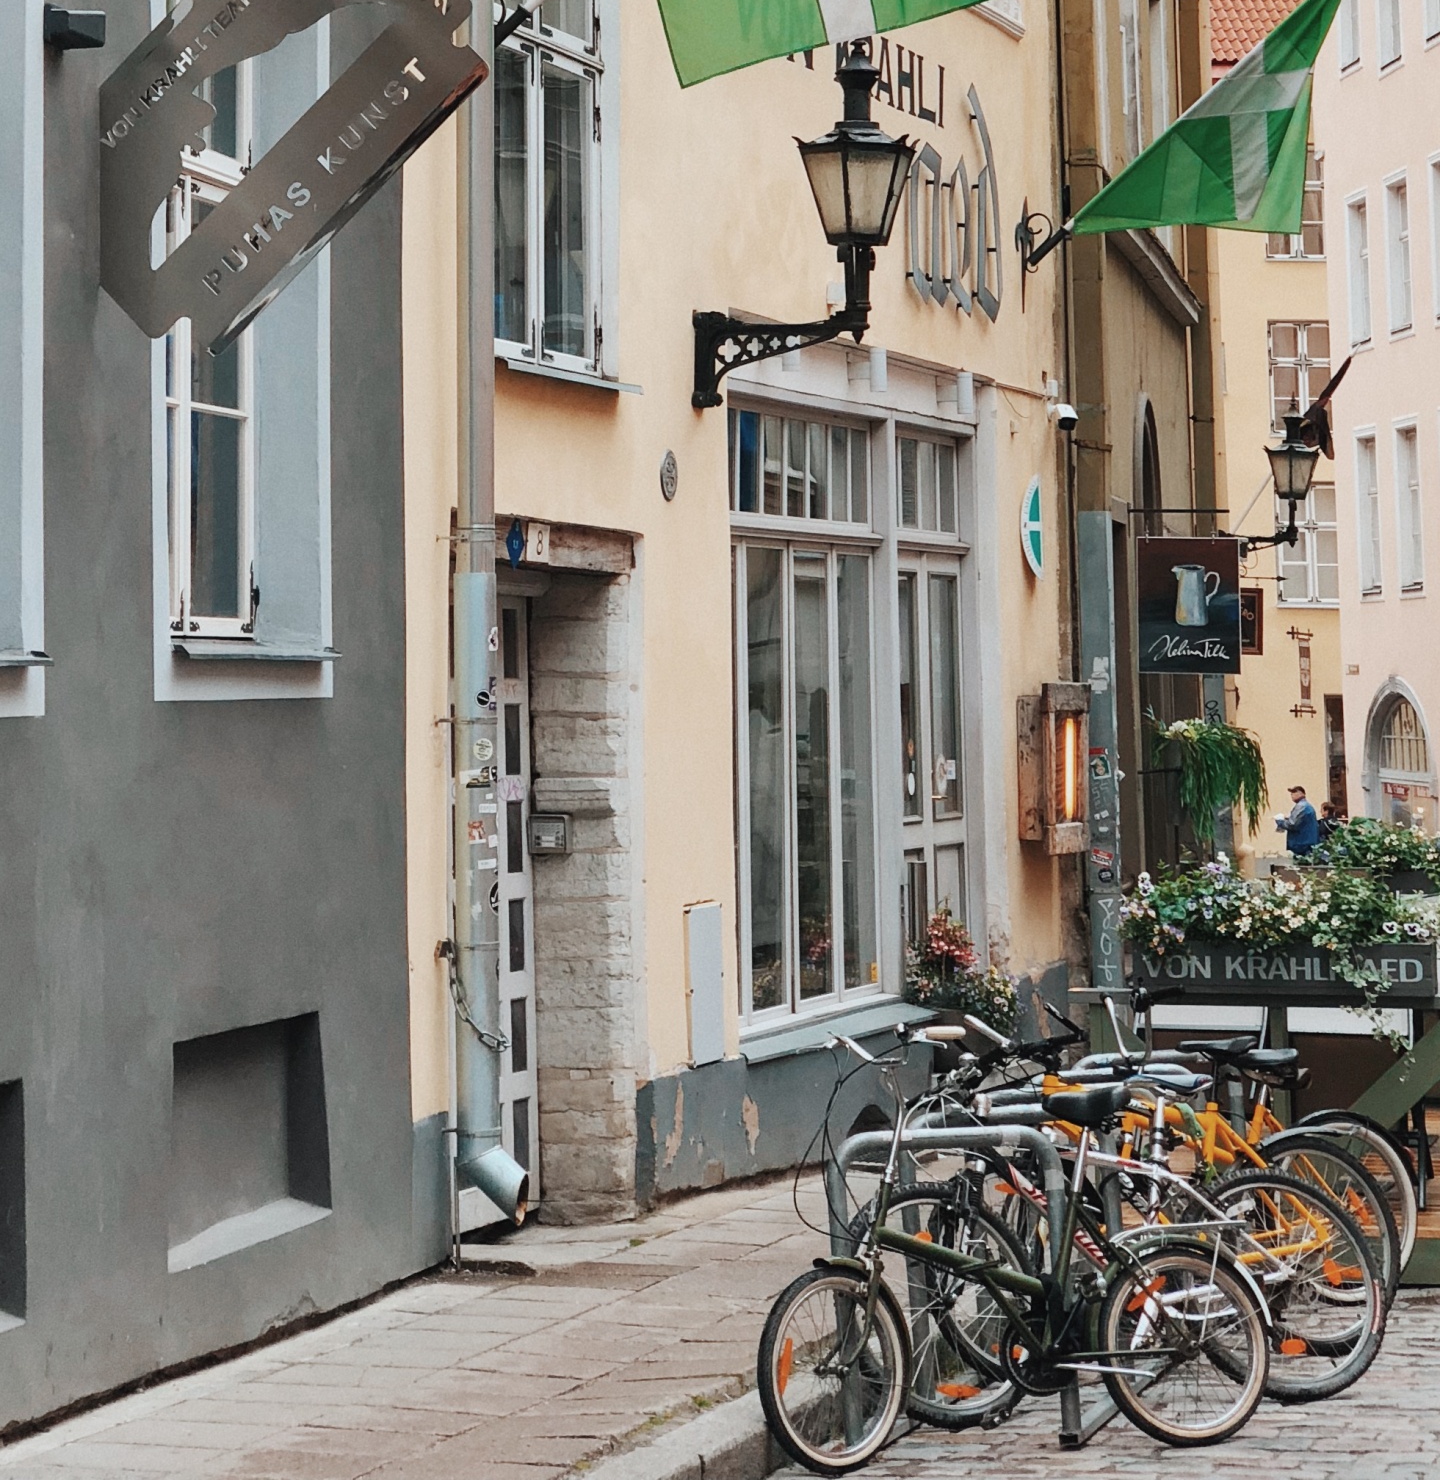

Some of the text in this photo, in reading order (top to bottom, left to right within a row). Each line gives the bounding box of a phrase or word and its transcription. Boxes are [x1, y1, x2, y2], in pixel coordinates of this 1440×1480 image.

[100, 107, 143, 149] VON
[139, 36, 208, 110] KRAHLI
[202, 57, 426, 296] PUHAS KUNST
[537, 530, 544, 556] 8
[1148, 634, 1231, 662] Helina Tilk
[1142, 954, 1212, 979] VON
